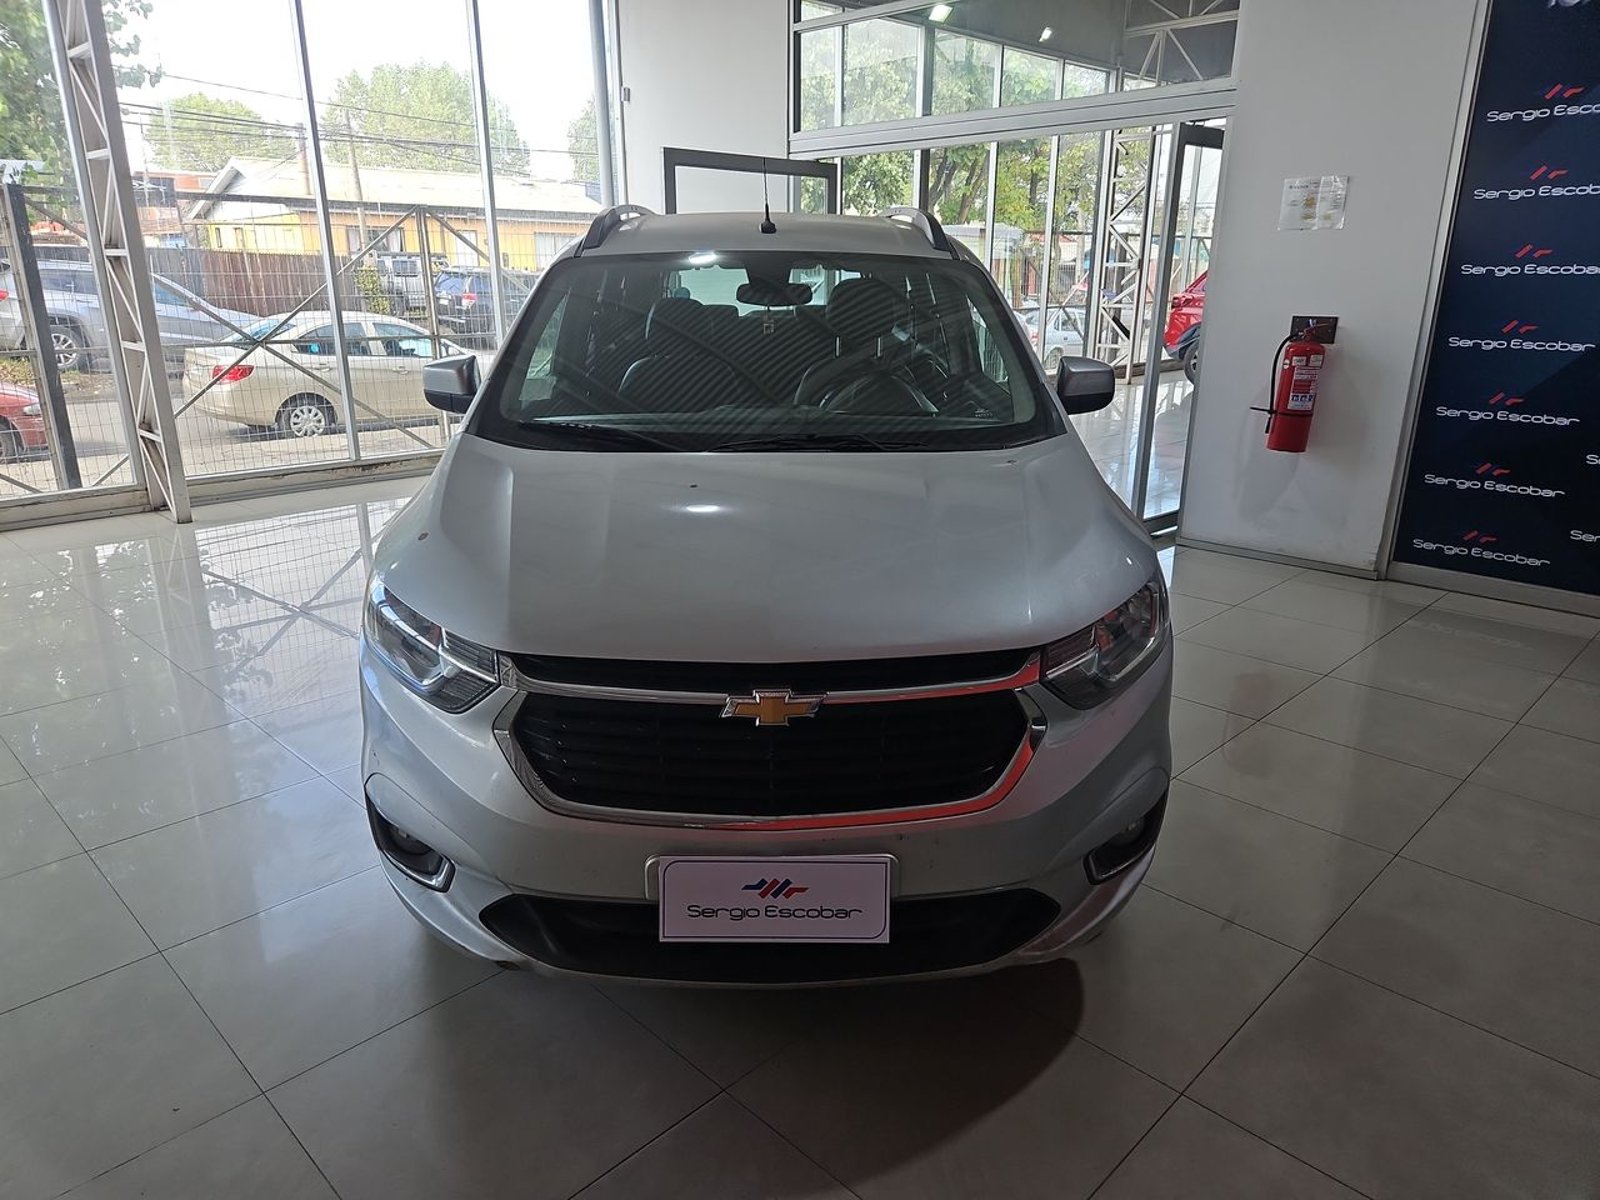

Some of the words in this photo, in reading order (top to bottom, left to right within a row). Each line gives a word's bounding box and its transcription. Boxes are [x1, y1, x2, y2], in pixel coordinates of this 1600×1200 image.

[1486, 108, 1551, 122] Sergio
[1473, 188, 1536, 201] Sergio
[1460, 264, 1522, 277] Sergio
[1524, 263, 1600, 275] Escoba
[1448, 336, 1508, 351] Sergio
[1510, 338, 1596, 352] Escobar
[1436, 406, 1495, 421] Sergio
[1496, 410, 1581, 426] Escobar
[1424, 474, 1482, 490] Sergio
[1483, 480, 1566, 498] Escobar
[1412, 538, 1469, 555] Sergio
[1470, 547, 1551, 567] Escobar
[686, 904, 761, 922] Sergio
[764, 904, 863, 920] Escobar
